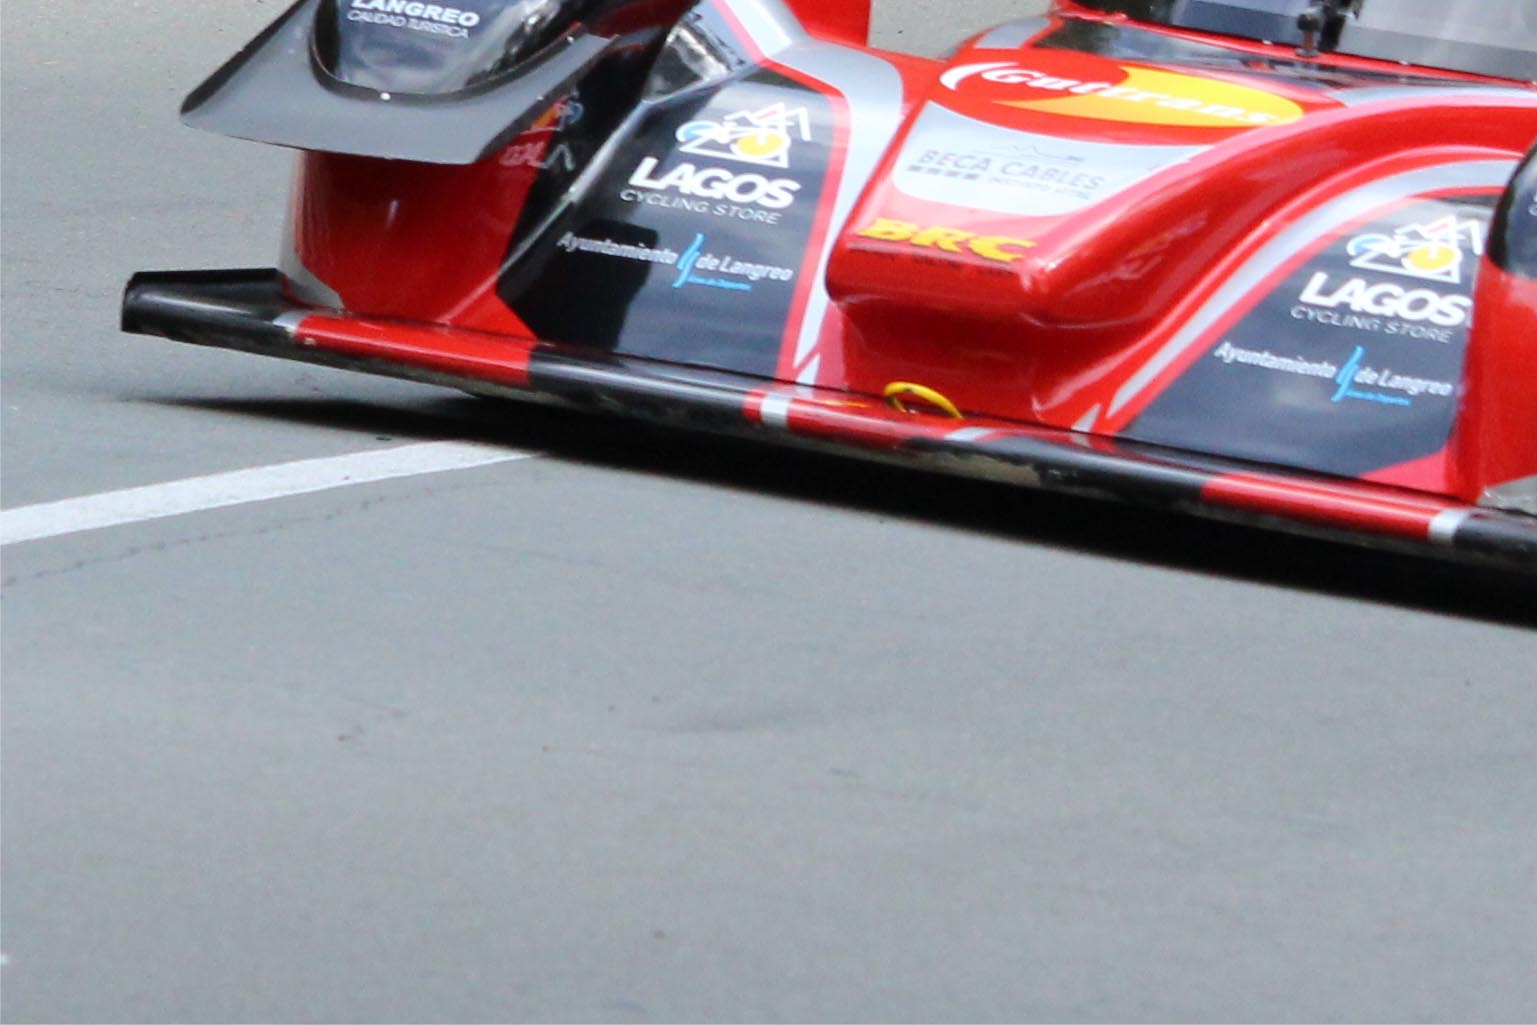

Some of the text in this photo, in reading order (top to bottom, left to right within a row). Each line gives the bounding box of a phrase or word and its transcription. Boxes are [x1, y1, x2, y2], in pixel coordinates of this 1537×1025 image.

[628, 156, 802, 209] LAGOS
[619, 189, 784, 226] CYCLING STORE
[856, 217, 1037, 262] BRC
[695, 251, 722, 271] de
[720, 255, 794, 282] Langreo
[1298, 271, 1475, 327] LAGOS
[1289, 304, 1455, 344] CYCLING STORE
[1377, 368, 1454, 397] Langreo
